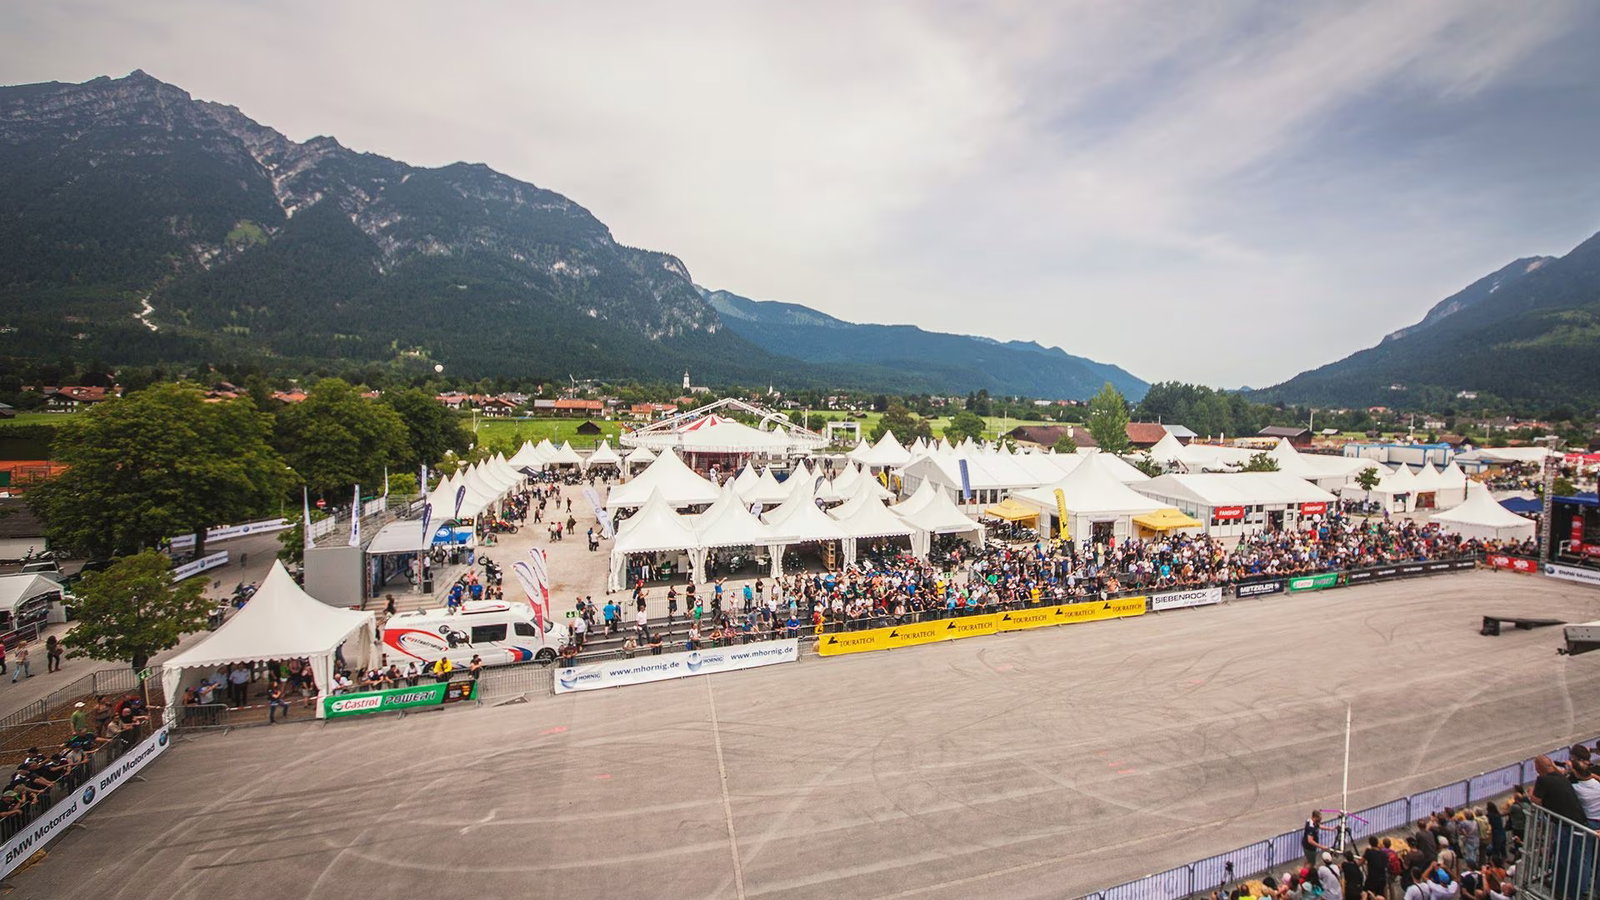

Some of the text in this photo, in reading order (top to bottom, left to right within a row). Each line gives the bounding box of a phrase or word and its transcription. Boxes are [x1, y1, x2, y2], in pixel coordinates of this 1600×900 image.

[1218, 509, 1241, 517] FANSHOP
[1239, 584, 1274, 593] METZELER
[1155, 591, 1207, 604] SIEBENROCK
[1063, 608, 1096, 618] TOURATECH
[1112, 603, 1143, 613] TOURATECH
[1012, 614, 1048, 624] TOURATECH
[957, 621, 993, 632] TOURATECH
[900, 629, 936, 641] TOURATECH
[839, 636, 875, 648] TOURATECH
[730, 645, 794, 661] www.mhornig.de
[578, 660, 680, 681] HORNIG www.mhornig.de
[345, 690, 437, 710] Castrol POWER1
[100, 743, 156, 791] BMW Motorrad
[5, 802, 78, 865] BMW Motorrad
